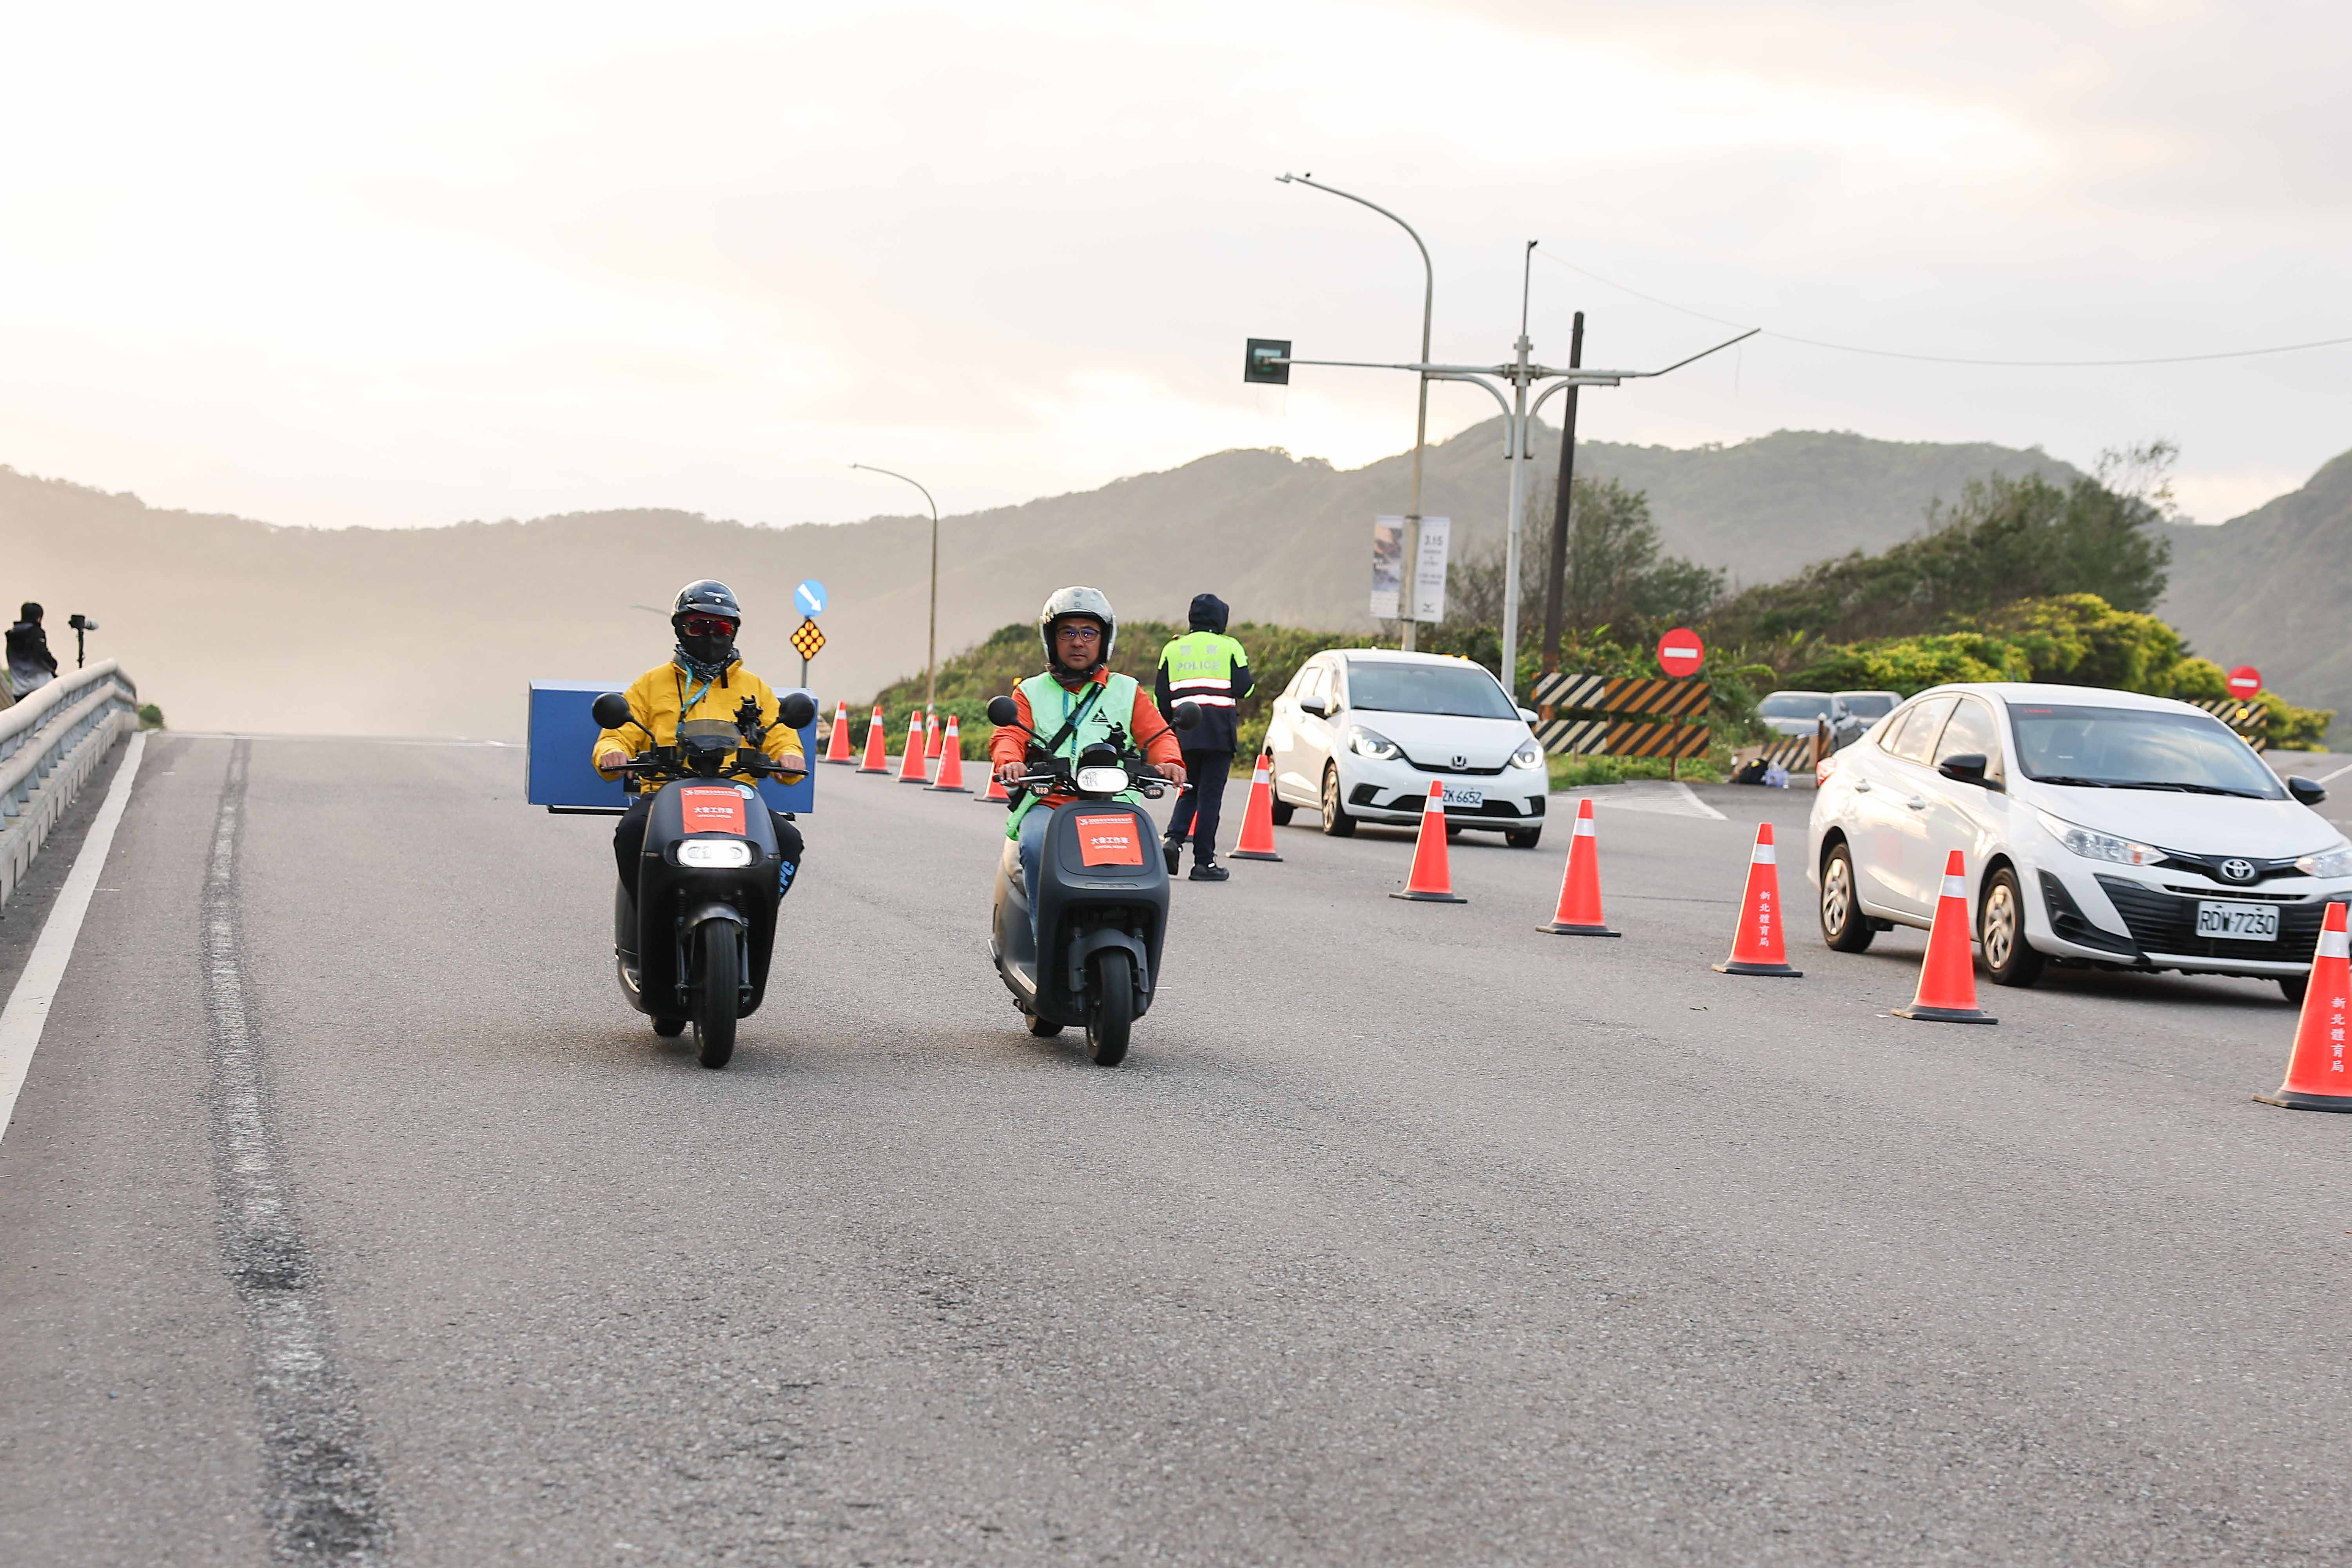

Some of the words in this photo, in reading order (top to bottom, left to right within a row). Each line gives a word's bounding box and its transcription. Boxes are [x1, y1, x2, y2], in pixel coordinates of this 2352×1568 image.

[1177, 661, 1220, 671] POLICE
[1759, 891, 1771, 947] 新北體育局
[2200, 910, 2276, 935] RDW-7230
[2330, 997, 2346, 1073] 新北體育局
